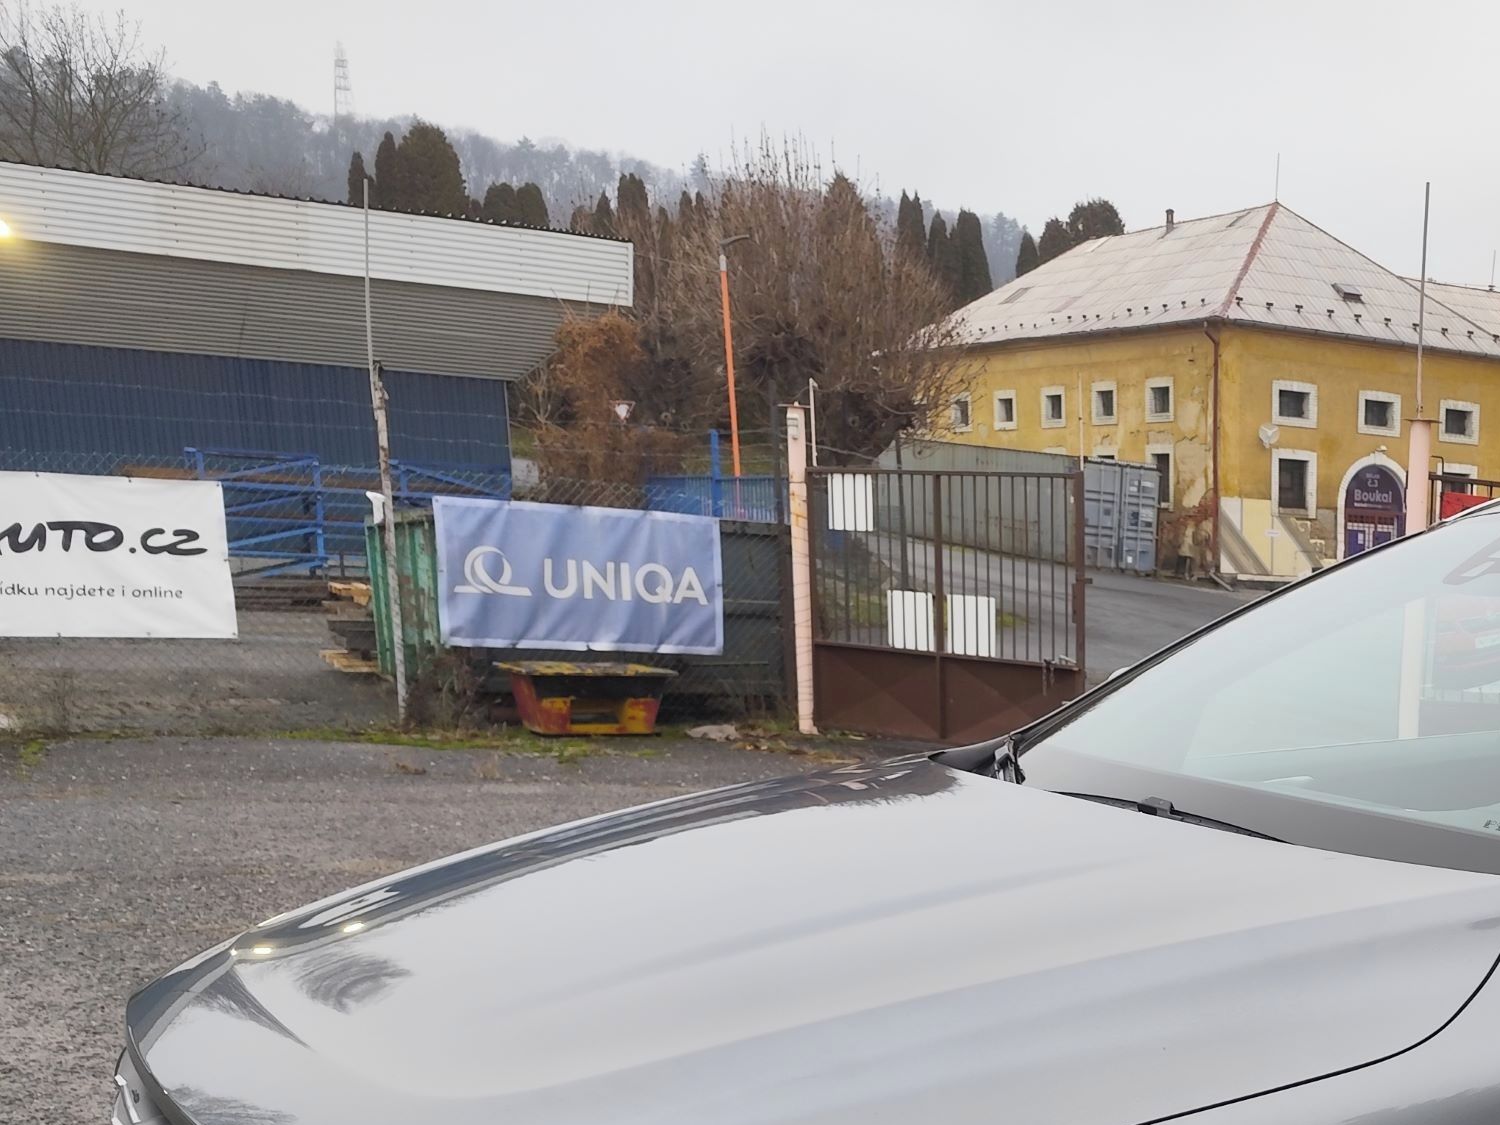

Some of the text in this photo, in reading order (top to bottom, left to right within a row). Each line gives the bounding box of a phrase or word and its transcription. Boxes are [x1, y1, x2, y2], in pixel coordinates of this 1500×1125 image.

[1353, 489, 1392, 503] Boukal
[544, 558, 709, 605] UNIQA
[45, 584, 115, 600] najdete
[121, 585, 125, 597] i
[131, 586, 183, 599] online
